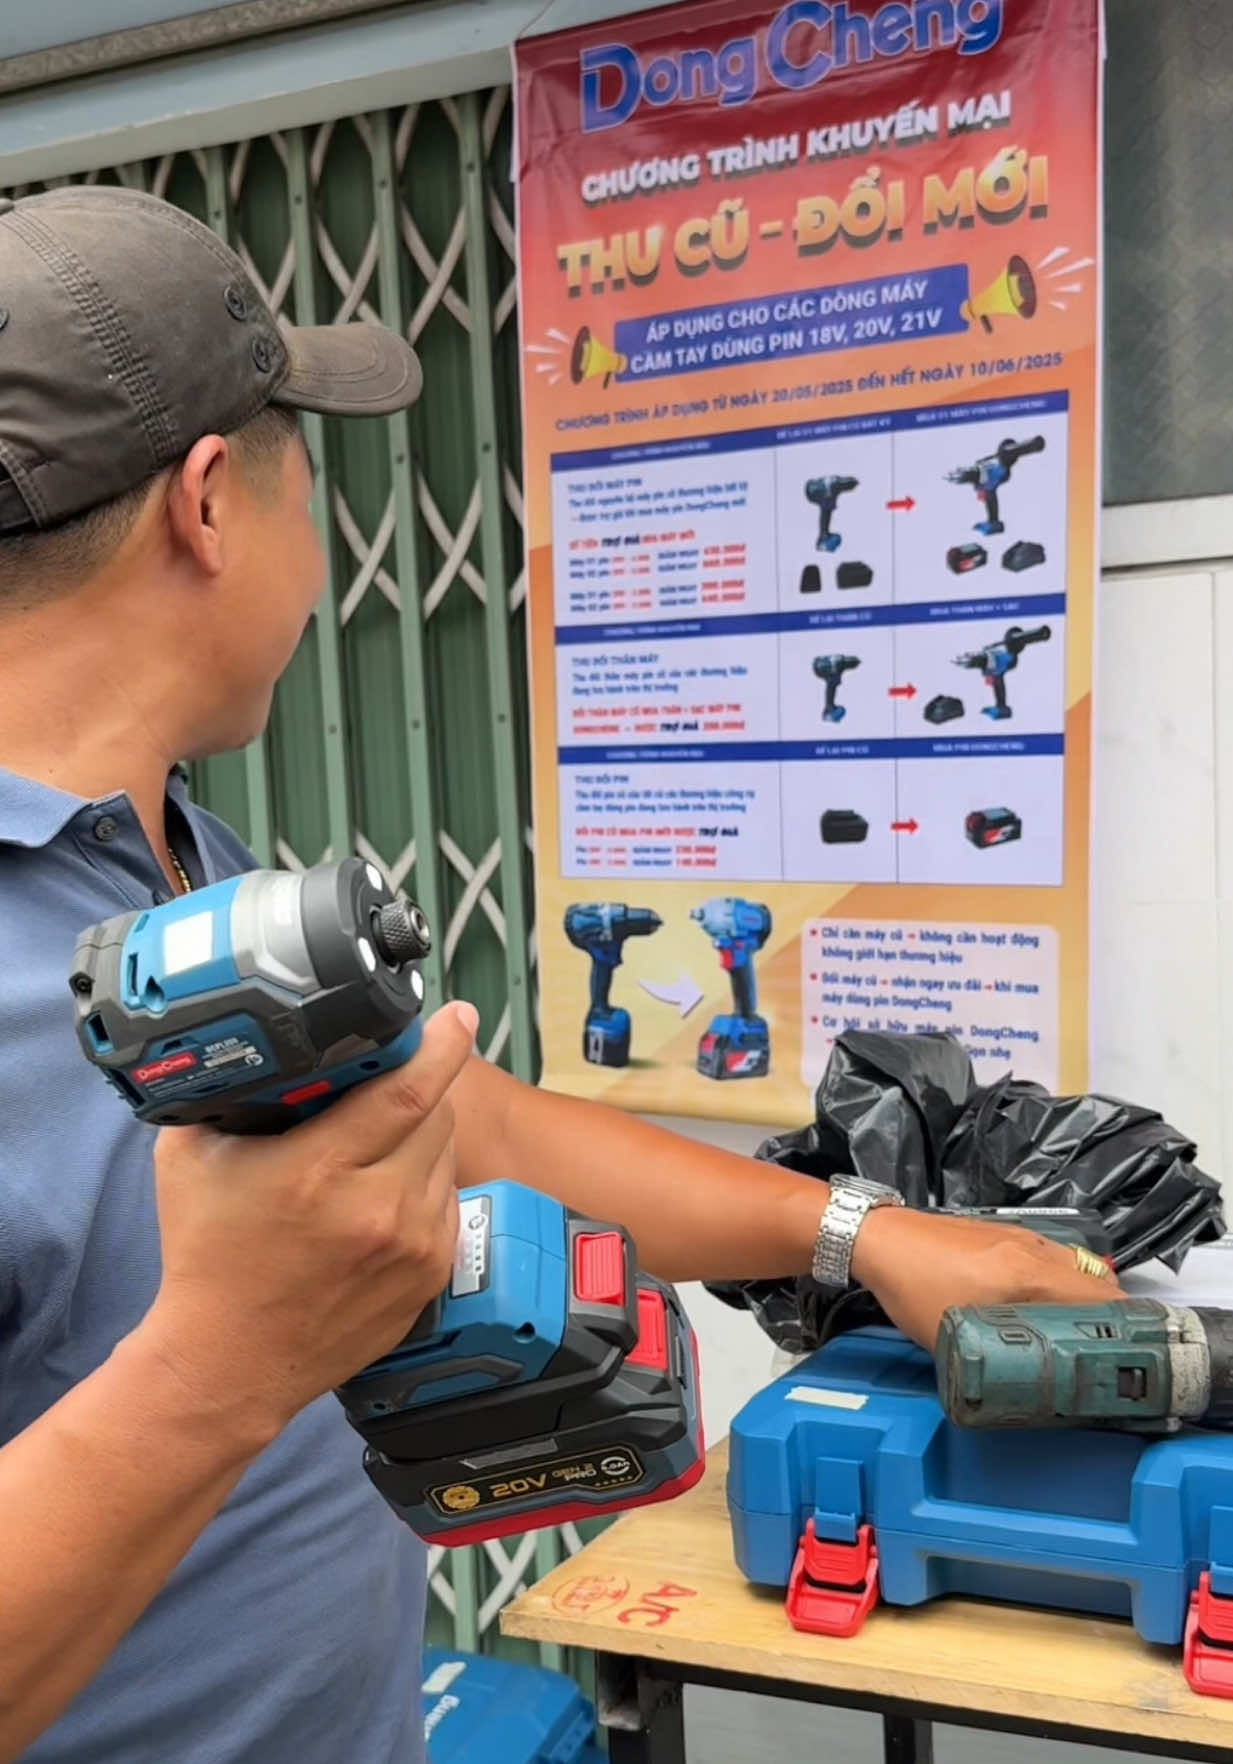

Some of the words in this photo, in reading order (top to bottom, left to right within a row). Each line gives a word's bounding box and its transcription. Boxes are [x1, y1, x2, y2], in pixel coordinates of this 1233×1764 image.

[579, 0, 1003, 134] DongCheng
[582, 153, 700, 204] CHƯƠNG
[707, 134, 799, 179] TRÌNH
[806, 97, 939, 161] KHUYẾN
[947, 90, 1012, 134] MẠI
[557, 222, 664, 297] THU
[673, 197, 750, 277] CŨ
[792, 165, 905, 257] ĐỔI
[922, 144, 1049, 236] MỚI
[646, 318, 670, 344] ÁP
[673, 313, 724, 339] DỤNG
[727, 304, 769, 329] CHO
[773, 297, 815, 322] CÁC
[820, 283, 877, 313] DÒNG
[881, 279, 928, 305] MÁY
[675, 348, 710, 367] TAY
[711, 339, 764, 362] DÙNG
[769, 331, 804, 351] PIN
[853, 316, 895, 338] 20V,
[900, 307, 943, 330] 21V
[556, 411, 611, 431] CHƯƠNG
[615, 407, 649, 425] TRÌNH
[652, 402, 668, 420] ÁP
[672, 400, 709, 419] DỤNG
[713, 392, 728, 412] TỪ
[729, 389, 768, 410] NGÀY
[857, 371, 886, 392] ĐẾN
[890, 366, 915, 387] HẾT
[920, 362, 965, 384] NGÀY
[822, 926, 839, 939] Chỉ
[843, 927, 861, 939] cần
[865, 928, 886, 943] máy
[890, 927, 903, 941] cũ
[919, 928, 952, 945] không
[956, 930, 977, 943] cần
[981, 931, 1006, 946] hoạt
[1010, 932, 1039, 948] động
[970, 1024, 1039, 1043] DongCheng
[488, 1473, 548, 1498] 20V
